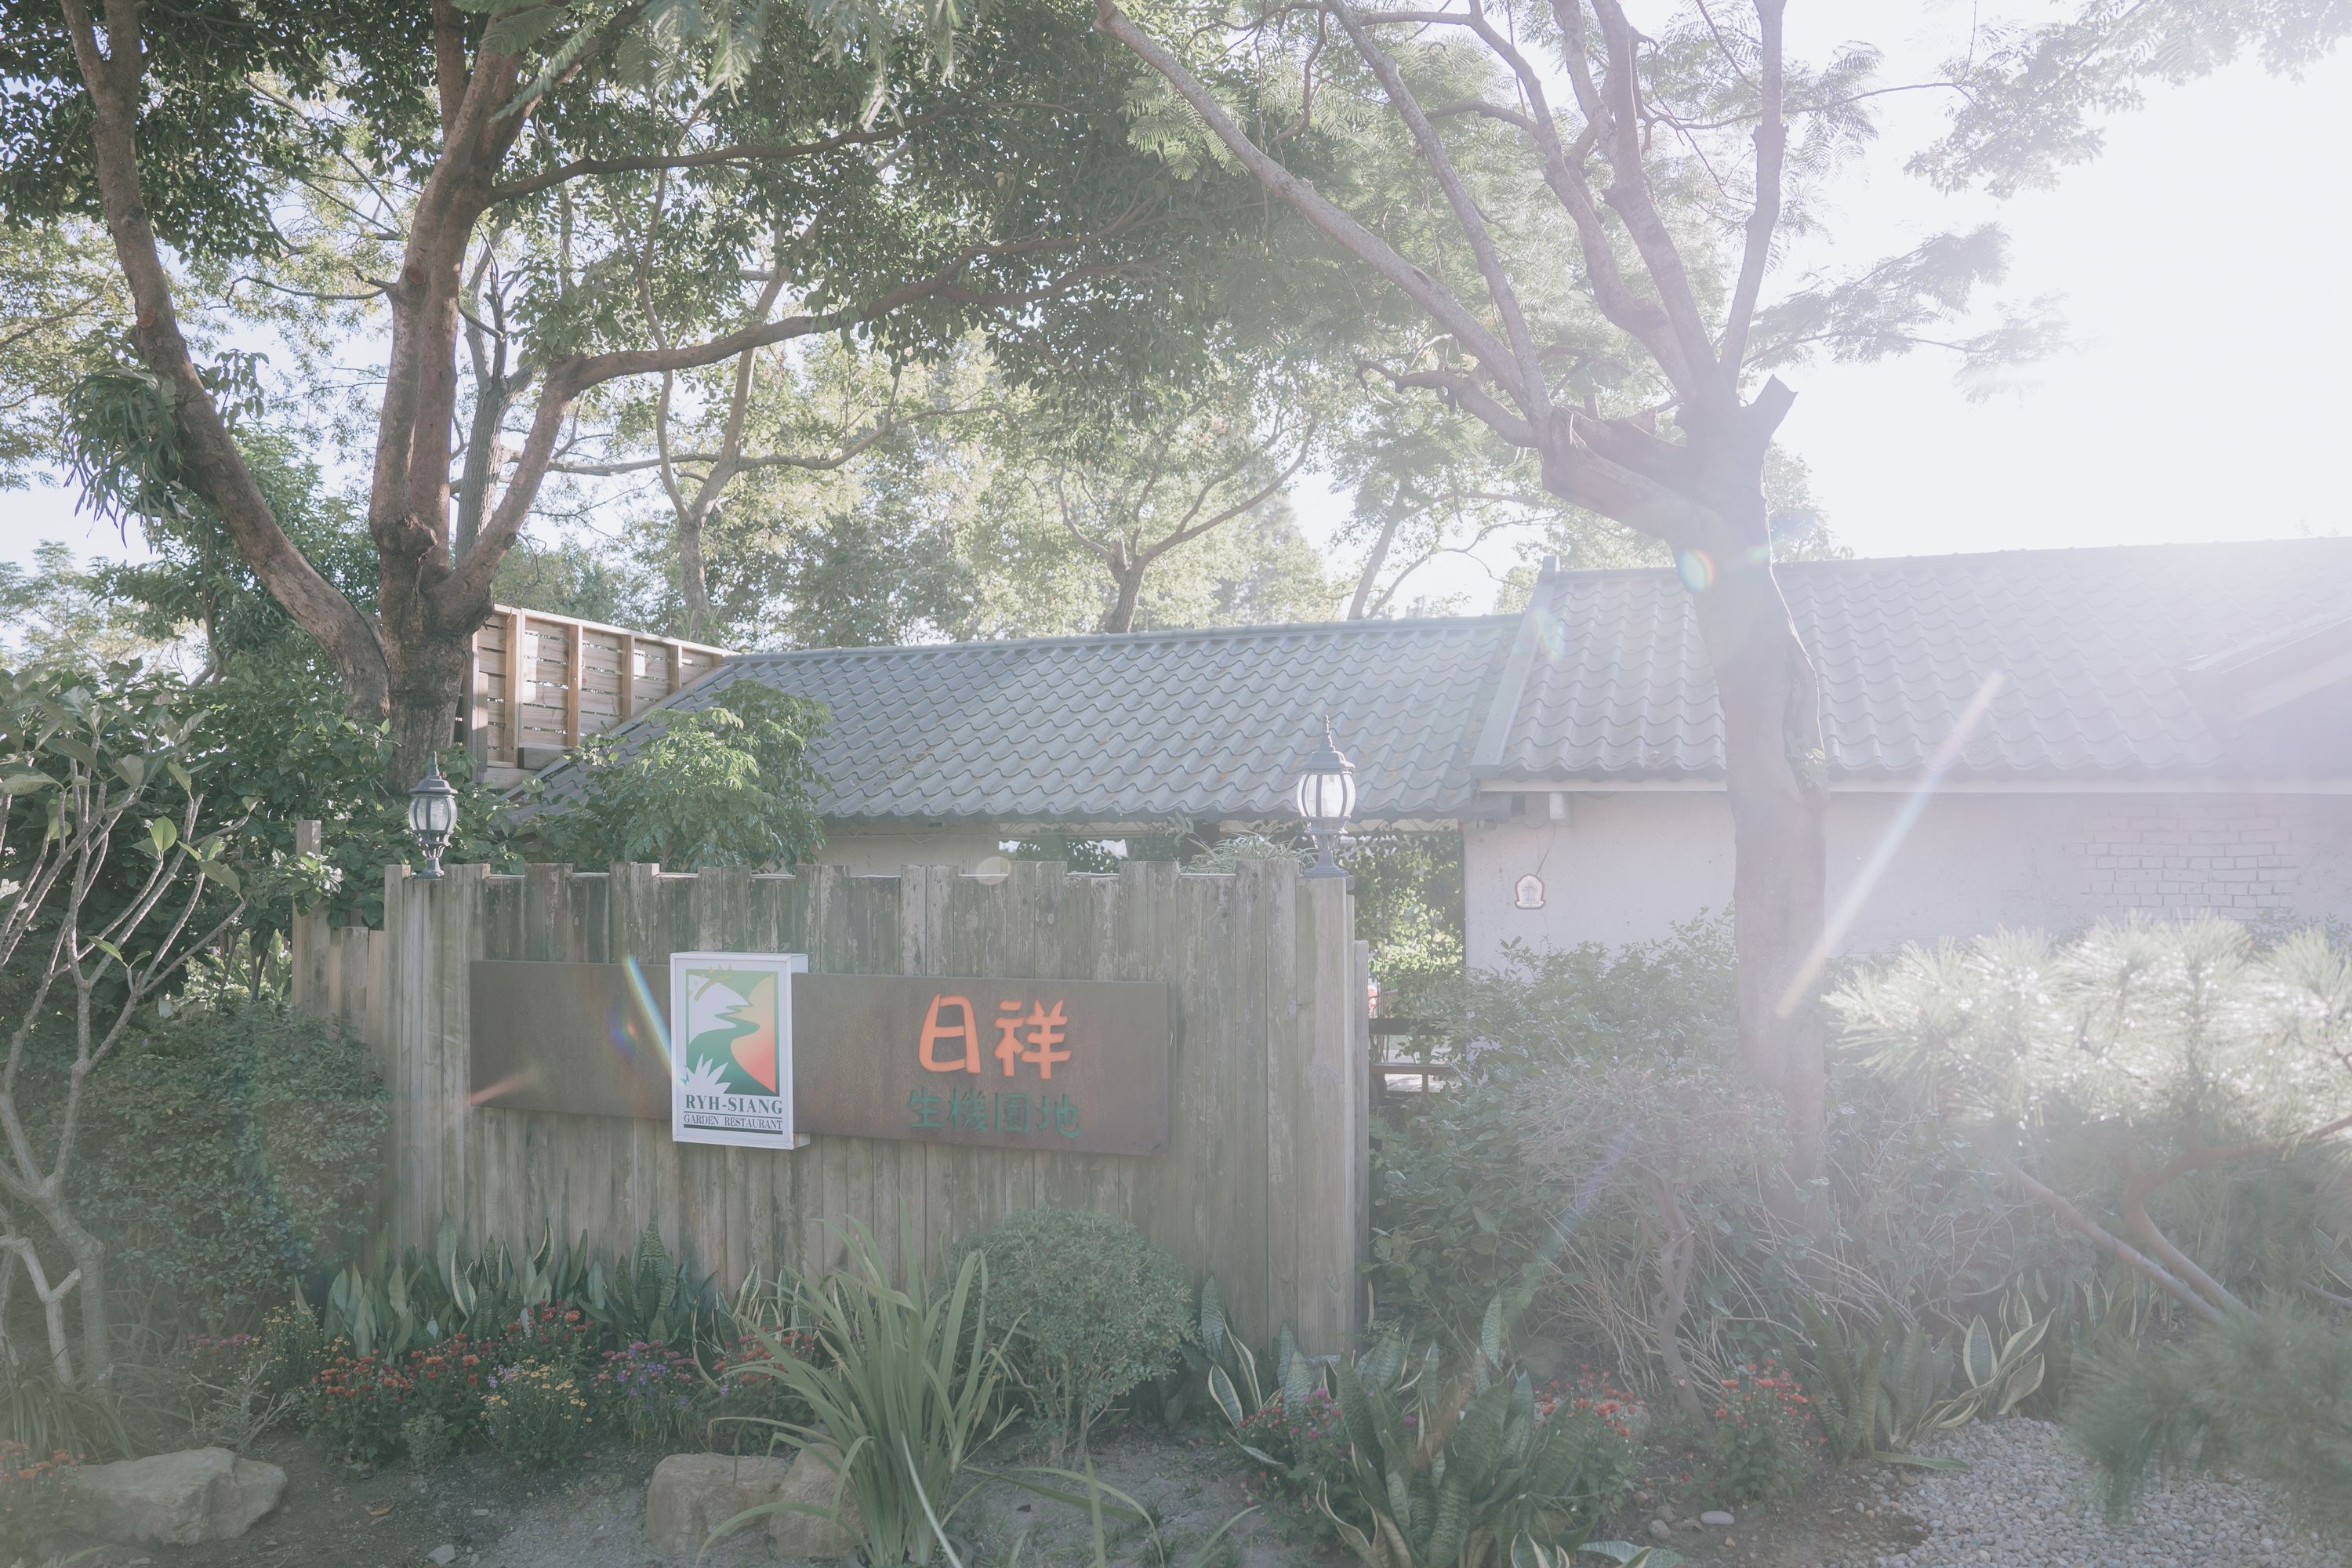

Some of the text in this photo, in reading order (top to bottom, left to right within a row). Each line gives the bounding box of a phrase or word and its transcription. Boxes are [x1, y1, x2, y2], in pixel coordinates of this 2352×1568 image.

[919, 992, 1072, 1080] 日祥
[685, 1094, 783, 1114] RYH-SIANG
[907, 1087, 1080, 1138] 生機園地
[684, 1114, 783, 1130] GARDEN RESTAURANT
